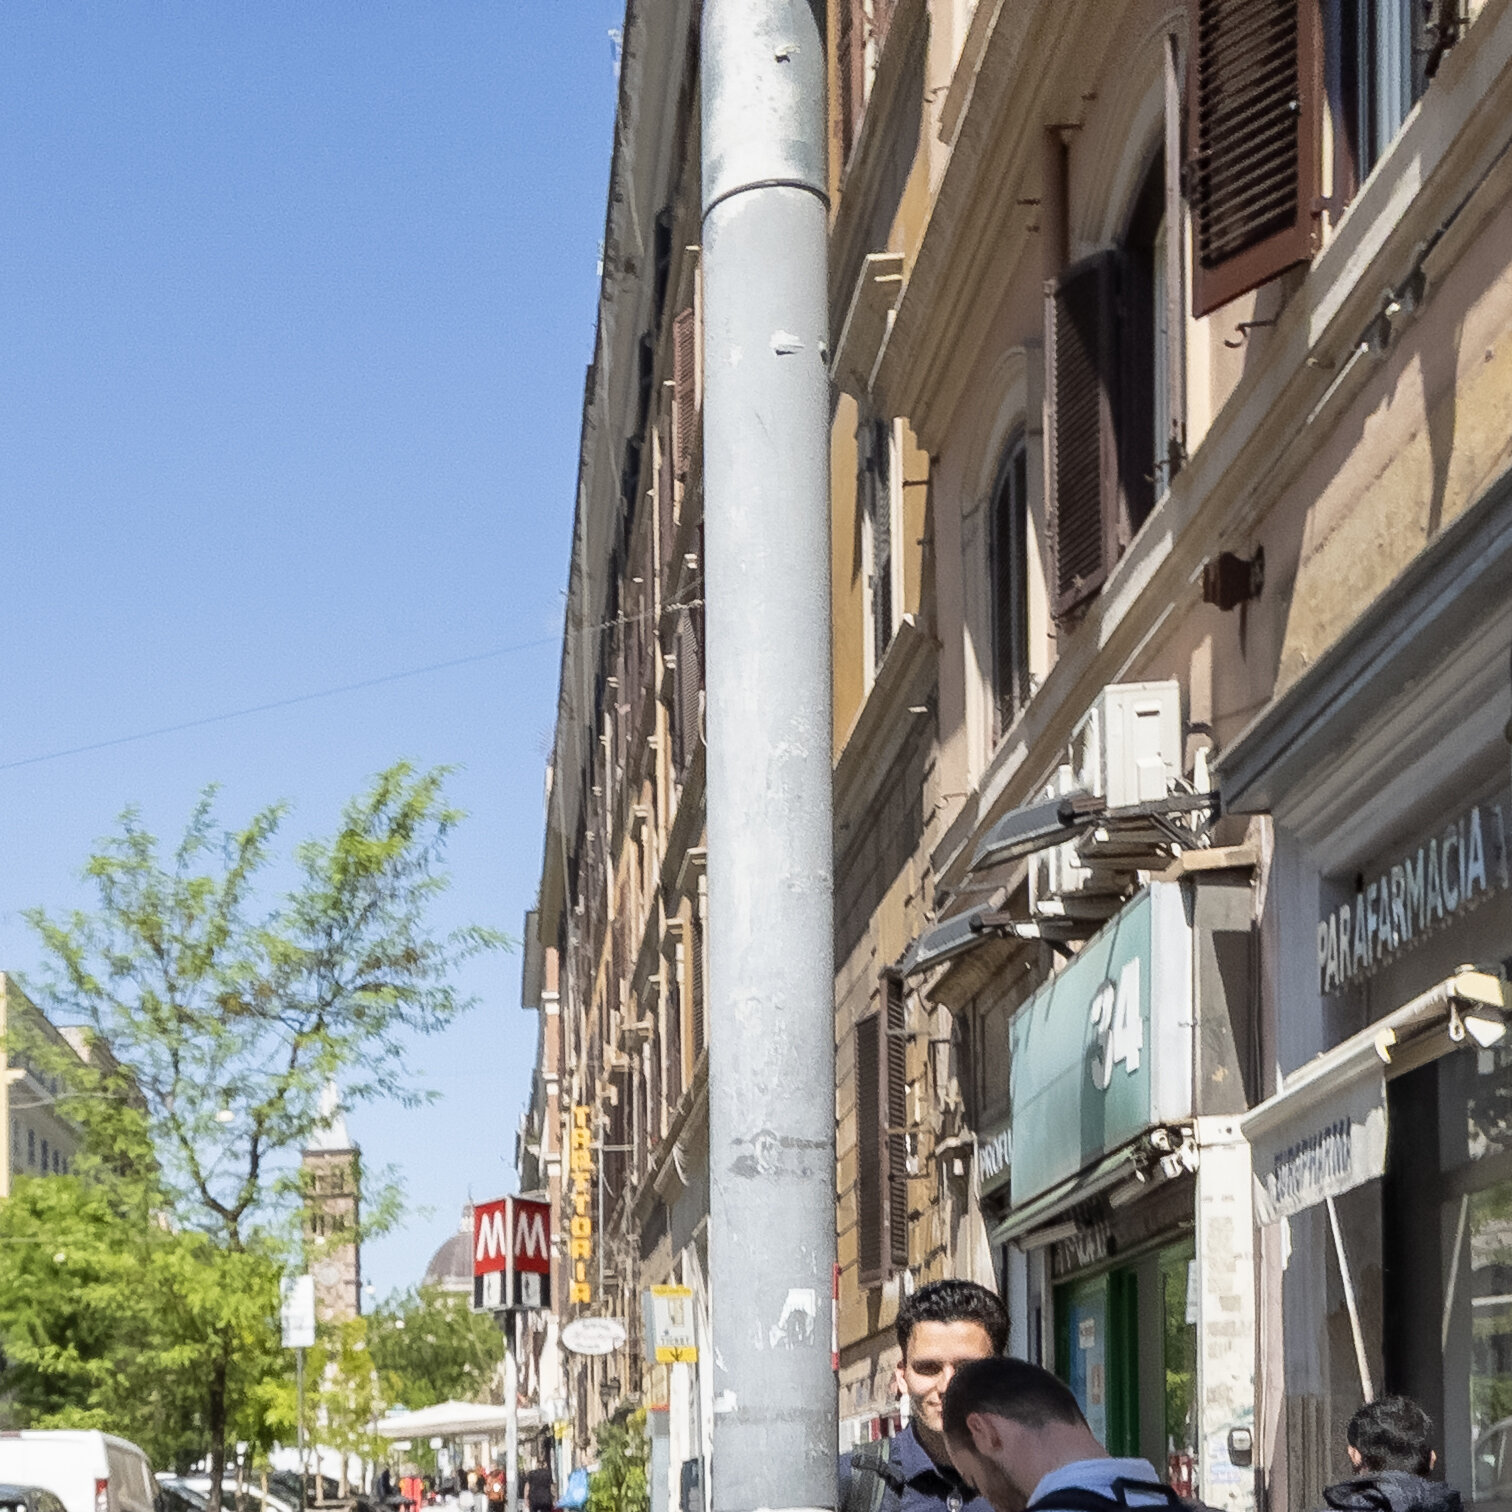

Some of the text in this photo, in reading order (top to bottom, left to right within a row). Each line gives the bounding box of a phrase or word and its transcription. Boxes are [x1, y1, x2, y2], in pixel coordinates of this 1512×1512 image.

[1316, 805, 1487, 993] PARAFARMACIA
[476, 1210, 506, 1262] M
[514, 1210, 548, 1261] M
